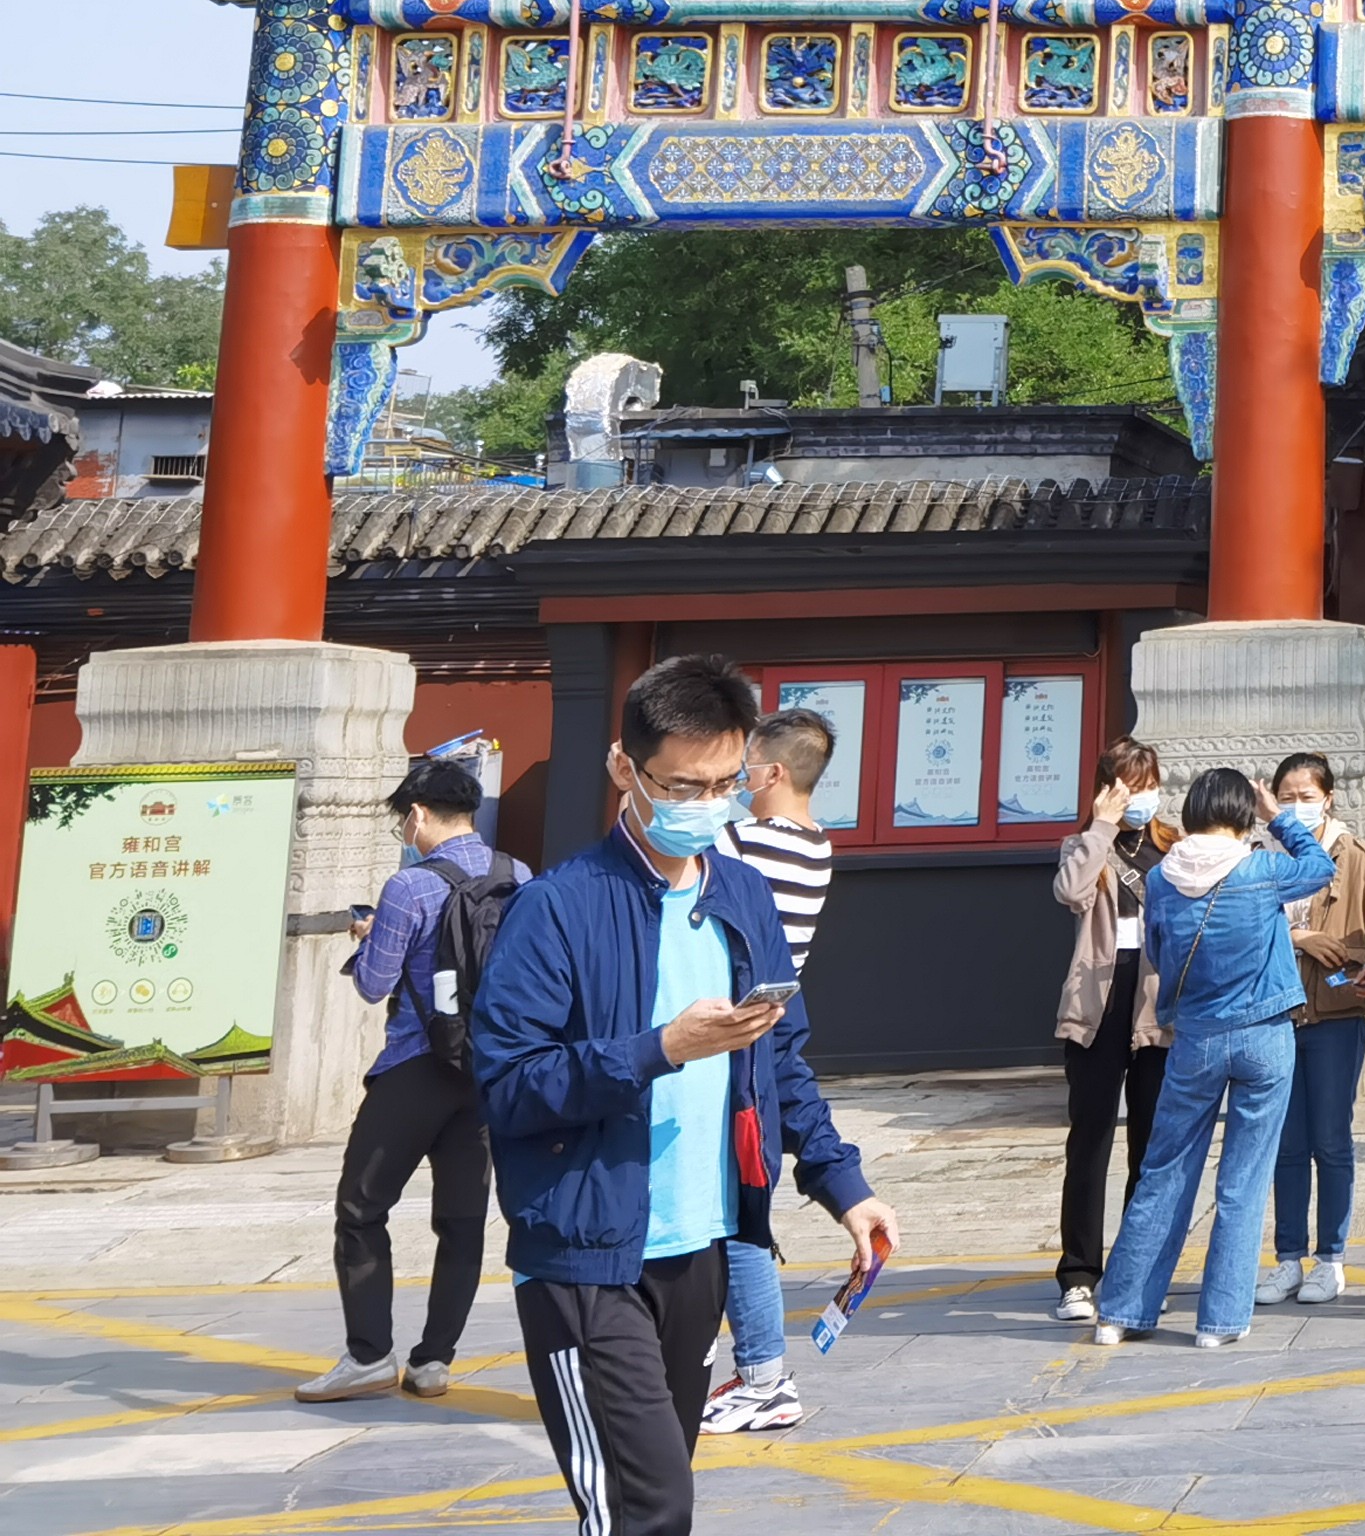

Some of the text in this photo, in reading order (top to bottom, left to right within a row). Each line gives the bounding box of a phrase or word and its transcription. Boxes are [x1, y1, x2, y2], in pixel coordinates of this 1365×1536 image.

[121, 834, 182, 854] 雍和宫
[89, 858, 211, 880] 官方语音讲解
